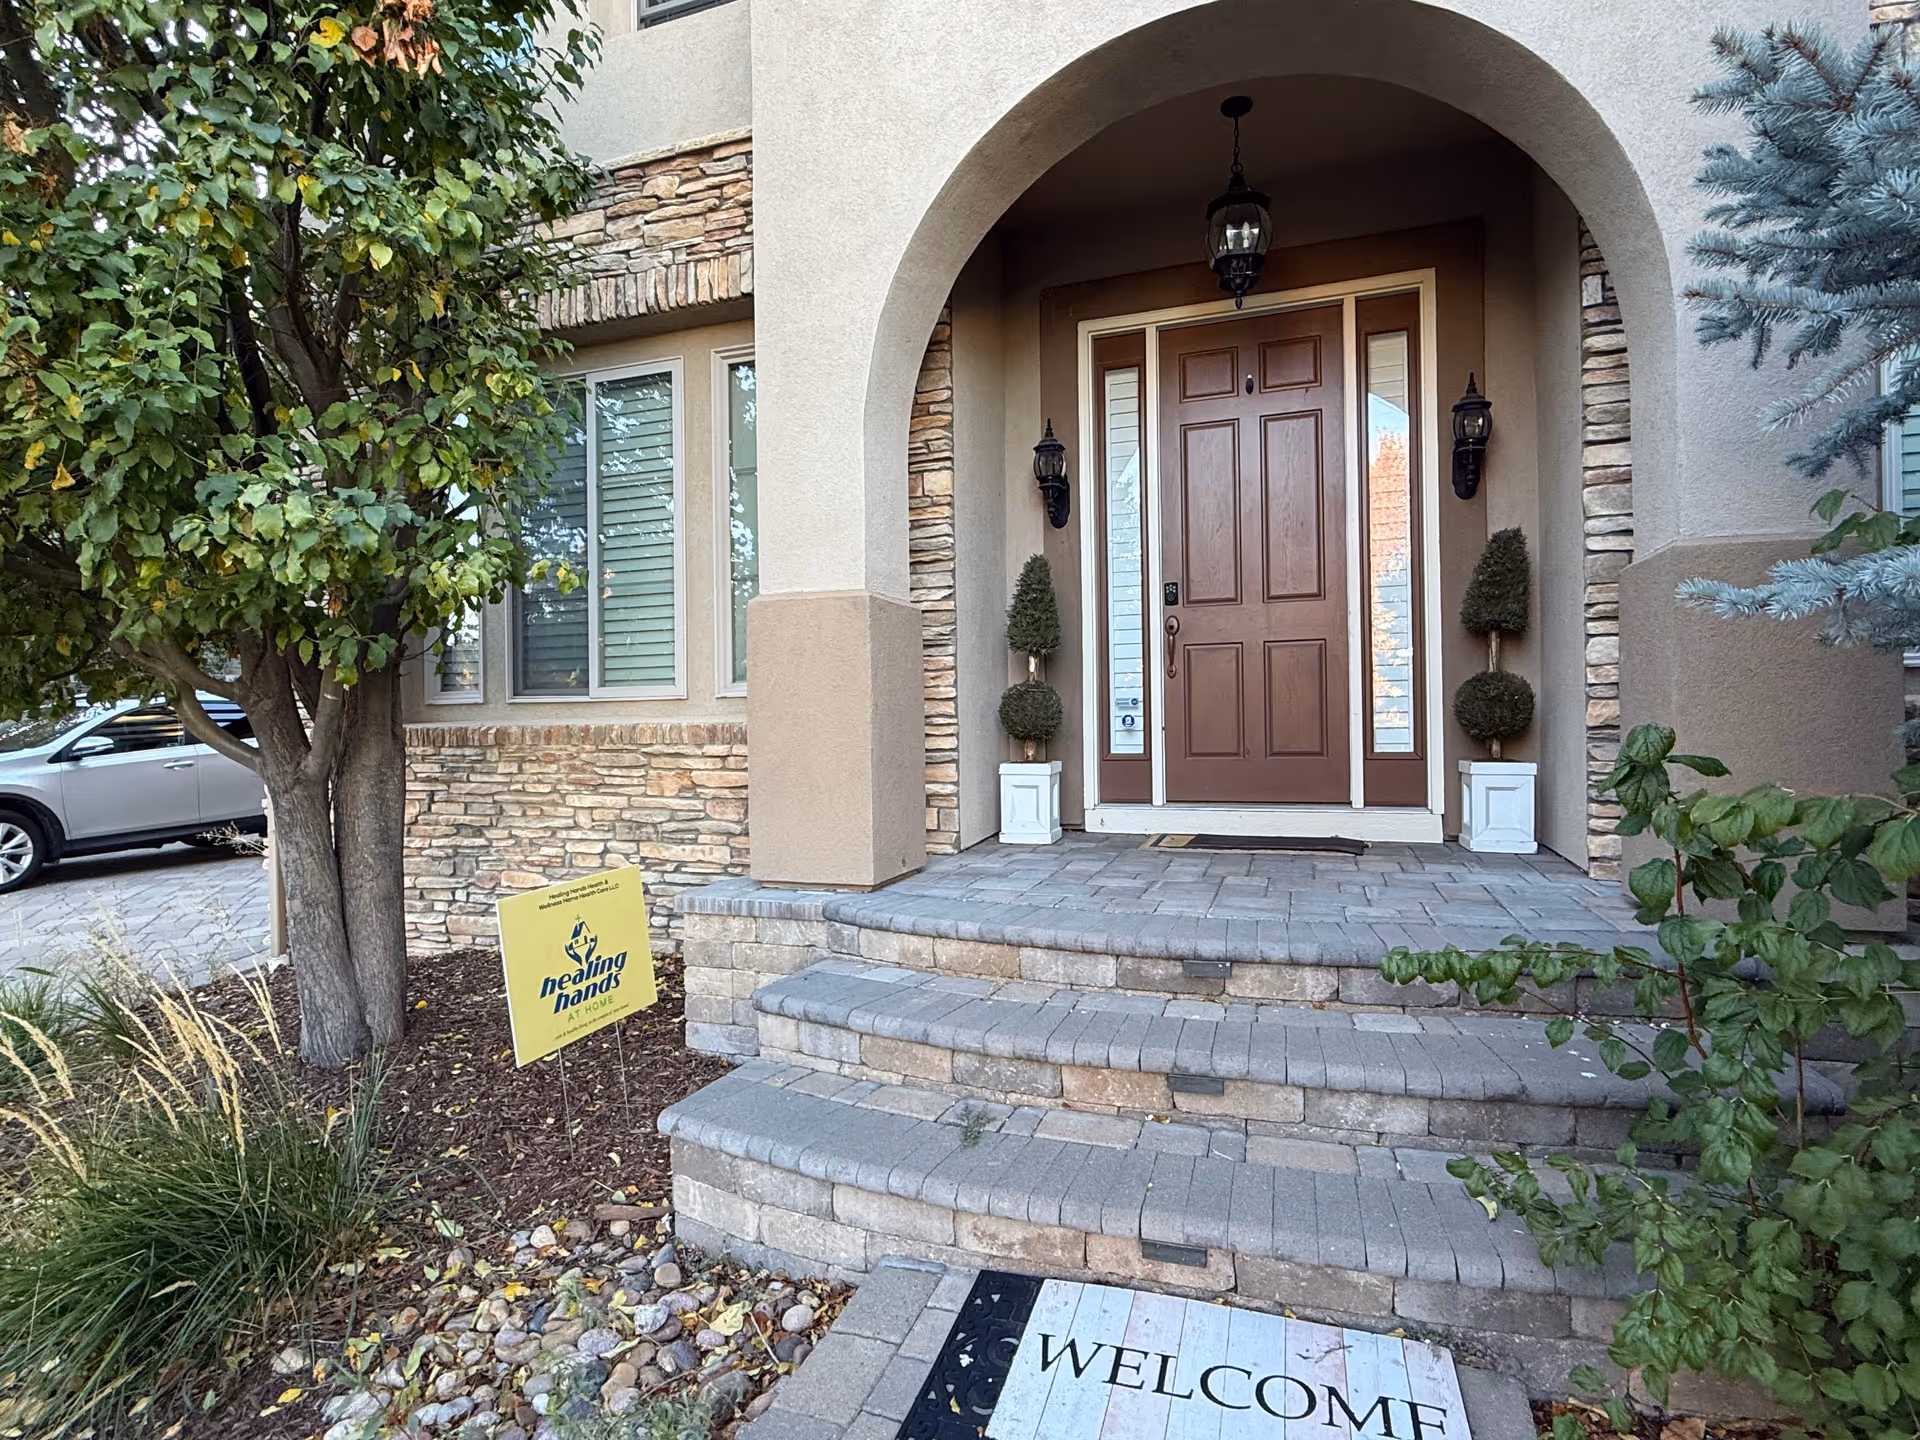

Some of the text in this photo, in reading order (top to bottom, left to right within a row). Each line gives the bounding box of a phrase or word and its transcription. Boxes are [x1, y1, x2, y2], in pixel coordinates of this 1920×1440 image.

[538, 882, 620, 910] Wellness Home Health Care LLC
[549, 891, 570, 900] Healing
[570, 886, 587, 895] Hands
[587, 881, 604, 890] Health
[540, 951, 628, 999] healing
[553, 972, 621, 1014] hands
[567, 1009, 581, 1023] AT
[585, 995, 614, 1014] HOME
[1038, 1333, 1447, 1440] WELCOME
